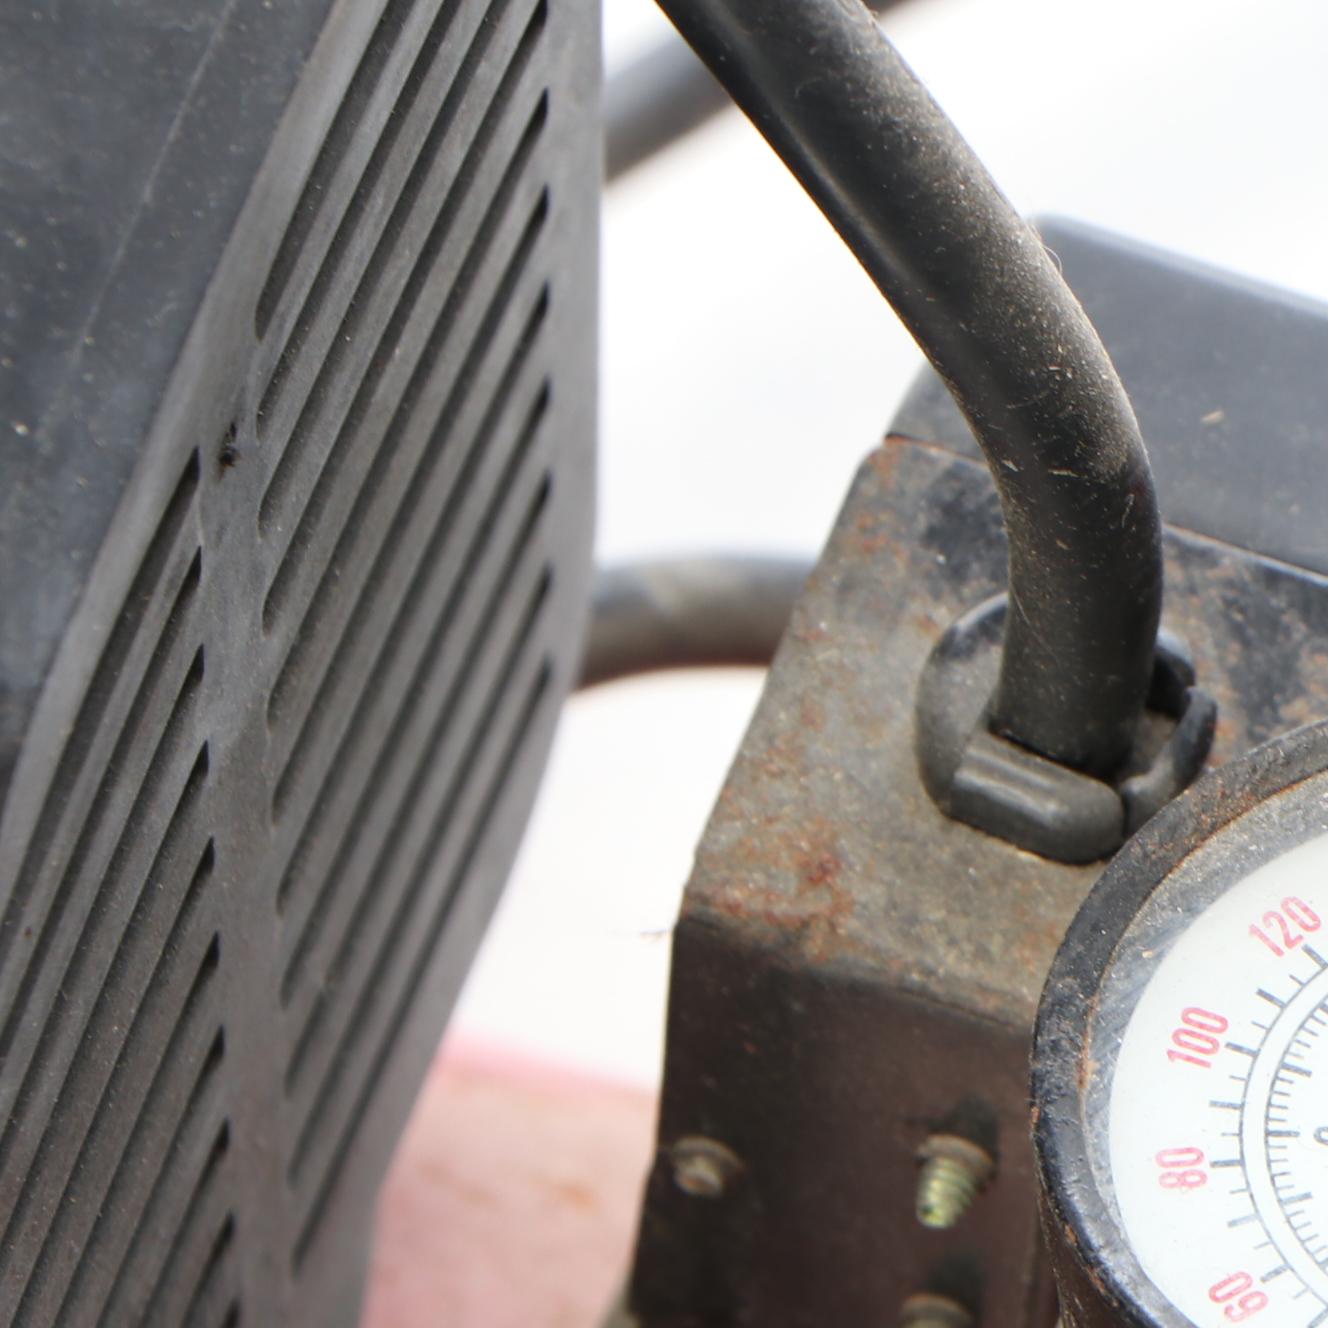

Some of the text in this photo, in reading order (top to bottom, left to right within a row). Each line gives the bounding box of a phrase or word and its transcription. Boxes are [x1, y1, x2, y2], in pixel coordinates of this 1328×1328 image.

[1249, 896, 1322, 957] 120
[1166, 1006, 1229, 1068] 100
[1155, 1146, 1208, 1189] 80
[1208, 1271, 1269, 1323] 60
